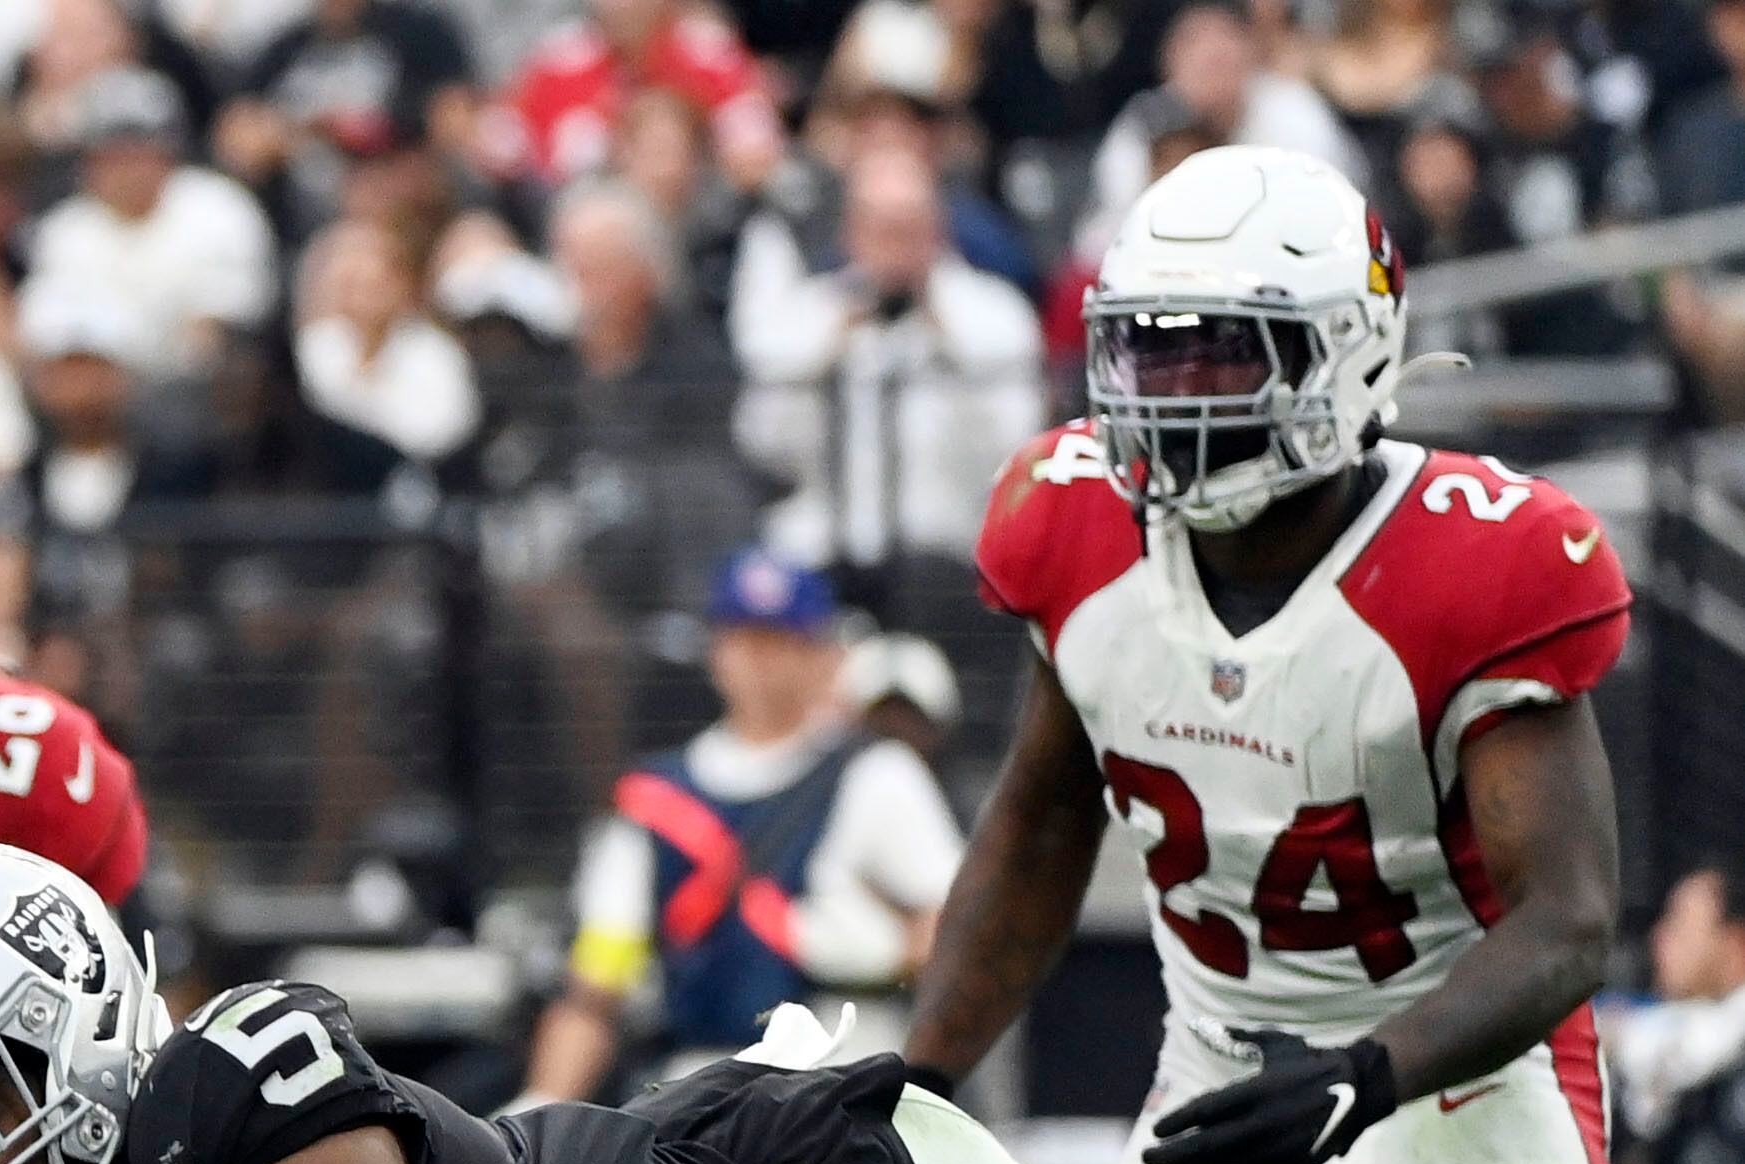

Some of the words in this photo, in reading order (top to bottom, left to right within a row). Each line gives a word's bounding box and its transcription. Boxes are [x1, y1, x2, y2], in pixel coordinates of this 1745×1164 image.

[1030, 418, 1111, 486] 4
[1144, 720, 1295, 768] CARDINALS
[1103, 749, 1419, 983] 24
[3, 887, 60, 938] RAIDERS
[201, 987, 346, 1107] 5
